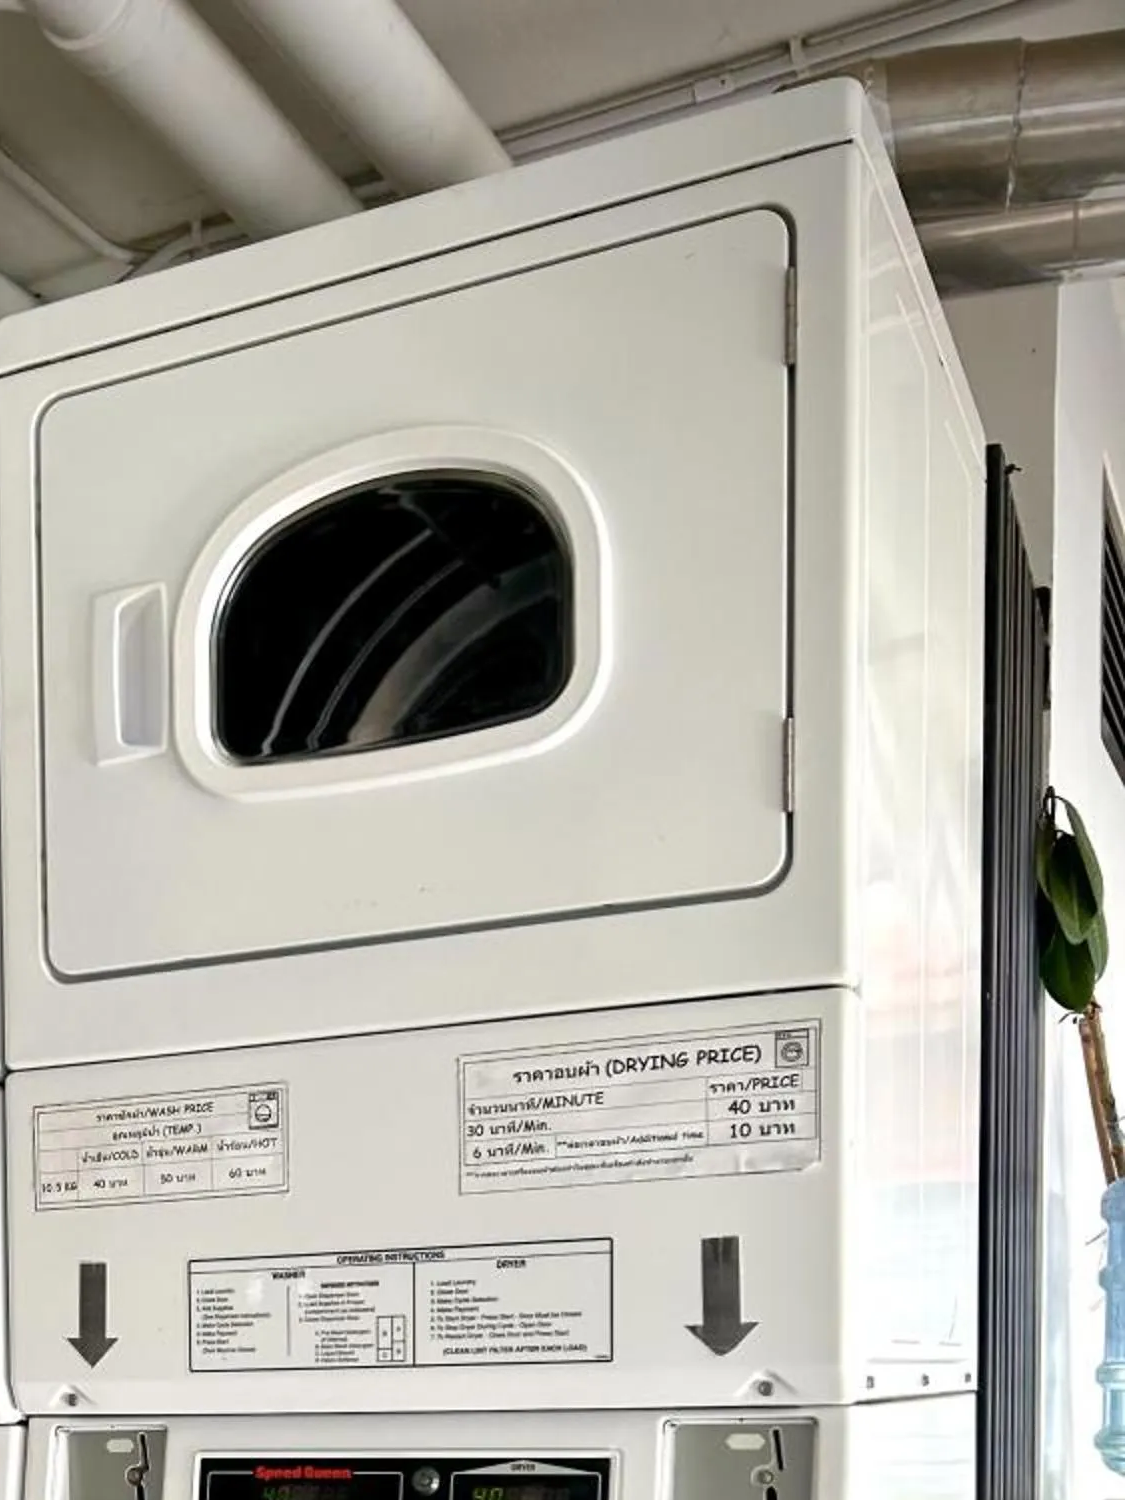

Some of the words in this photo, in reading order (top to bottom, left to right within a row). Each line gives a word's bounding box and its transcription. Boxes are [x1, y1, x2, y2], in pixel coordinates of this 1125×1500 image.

[513, 1060, 600, 1083] ราคาอบผ้า
[606, 1052, 689, 1077] (DRYING
[696, 1045, 762, 1065] PRICE)
[709, 1073, 800, 1094] ราคา/PRICE
[185, 1101, 214, 1113] PRICE
[728, 1099, 751, 1115] 40
[759, 1099, 795, 1113] บาท
[467, 1123, 483, 1137] 30
[730, 1123, 751, 1138] 10
[759, 1122, 796, 1136] บาท
[472, 1148, 481, 1159] 6
[228, 1168, 242, 1178] 60
[94, 1179, 106, 1188] 40
[496, 1259, 526, 1269] DRYER
[255, 1466, 302, 1481] Speed
[304, 1467, 351, 1480] Queen
